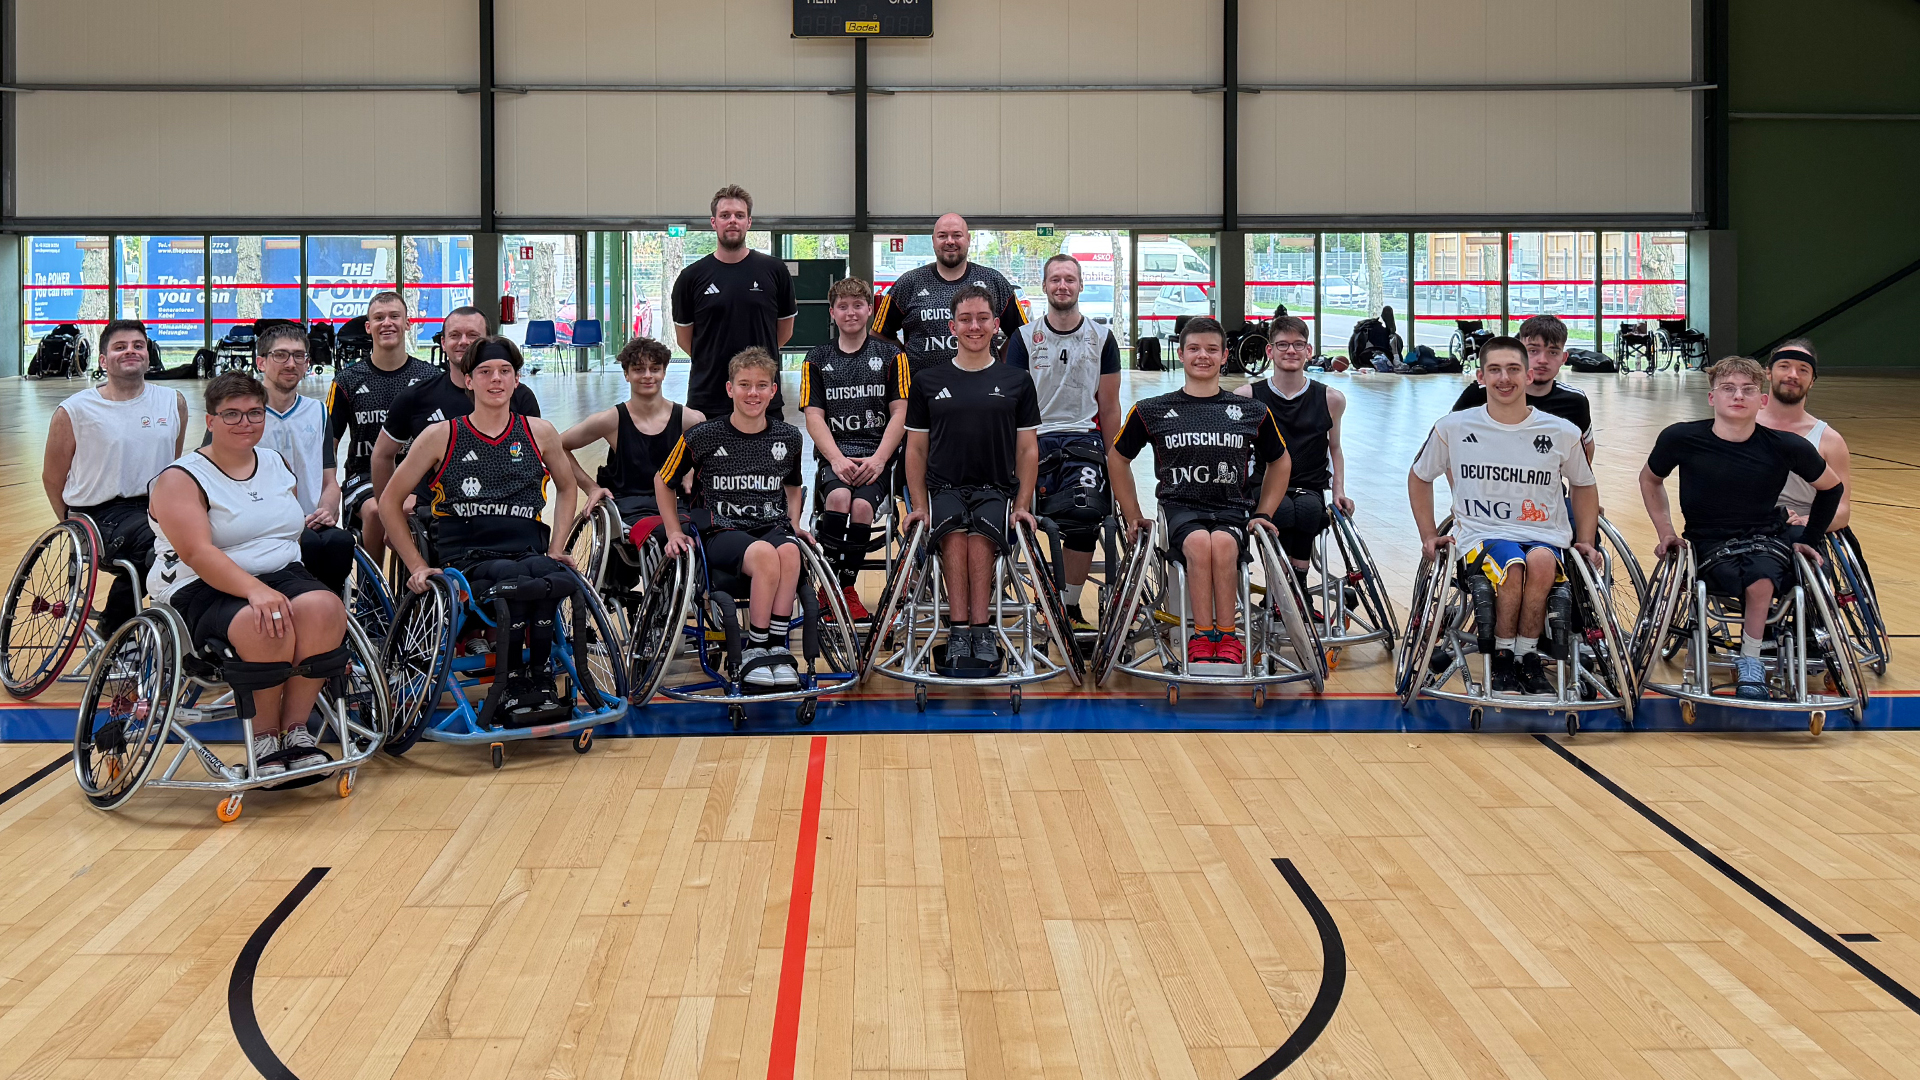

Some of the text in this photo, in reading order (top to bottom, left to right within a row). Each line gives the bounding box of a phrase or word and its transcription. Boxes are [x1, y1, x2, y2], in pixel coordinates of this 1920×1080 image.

[848, 22, 878, 31] Bodet
[341, 263, 373, 276] THE
[158, 276, 191, 290] The
[157, 292, 191, 307] you
[196, 292, 230, 304] can
[924, 336, 959, 351] ING
[1060, 349, 1068, 365] 4
[826, 384, 886, 401] EUTSCHLAND
[828, 415, 861, 432] NG
[1164, 432, 1244, 449] DEUTSCHLAND
[713, 475, 784, 491] DEUTSCHLAN
[1170, 465, 1211, 485] ING
[1461, 464, 1552, 486] DEUTSCHLAND
[717, 501, 759, 517] ING
[1464, 499, 1512, 520] ING
